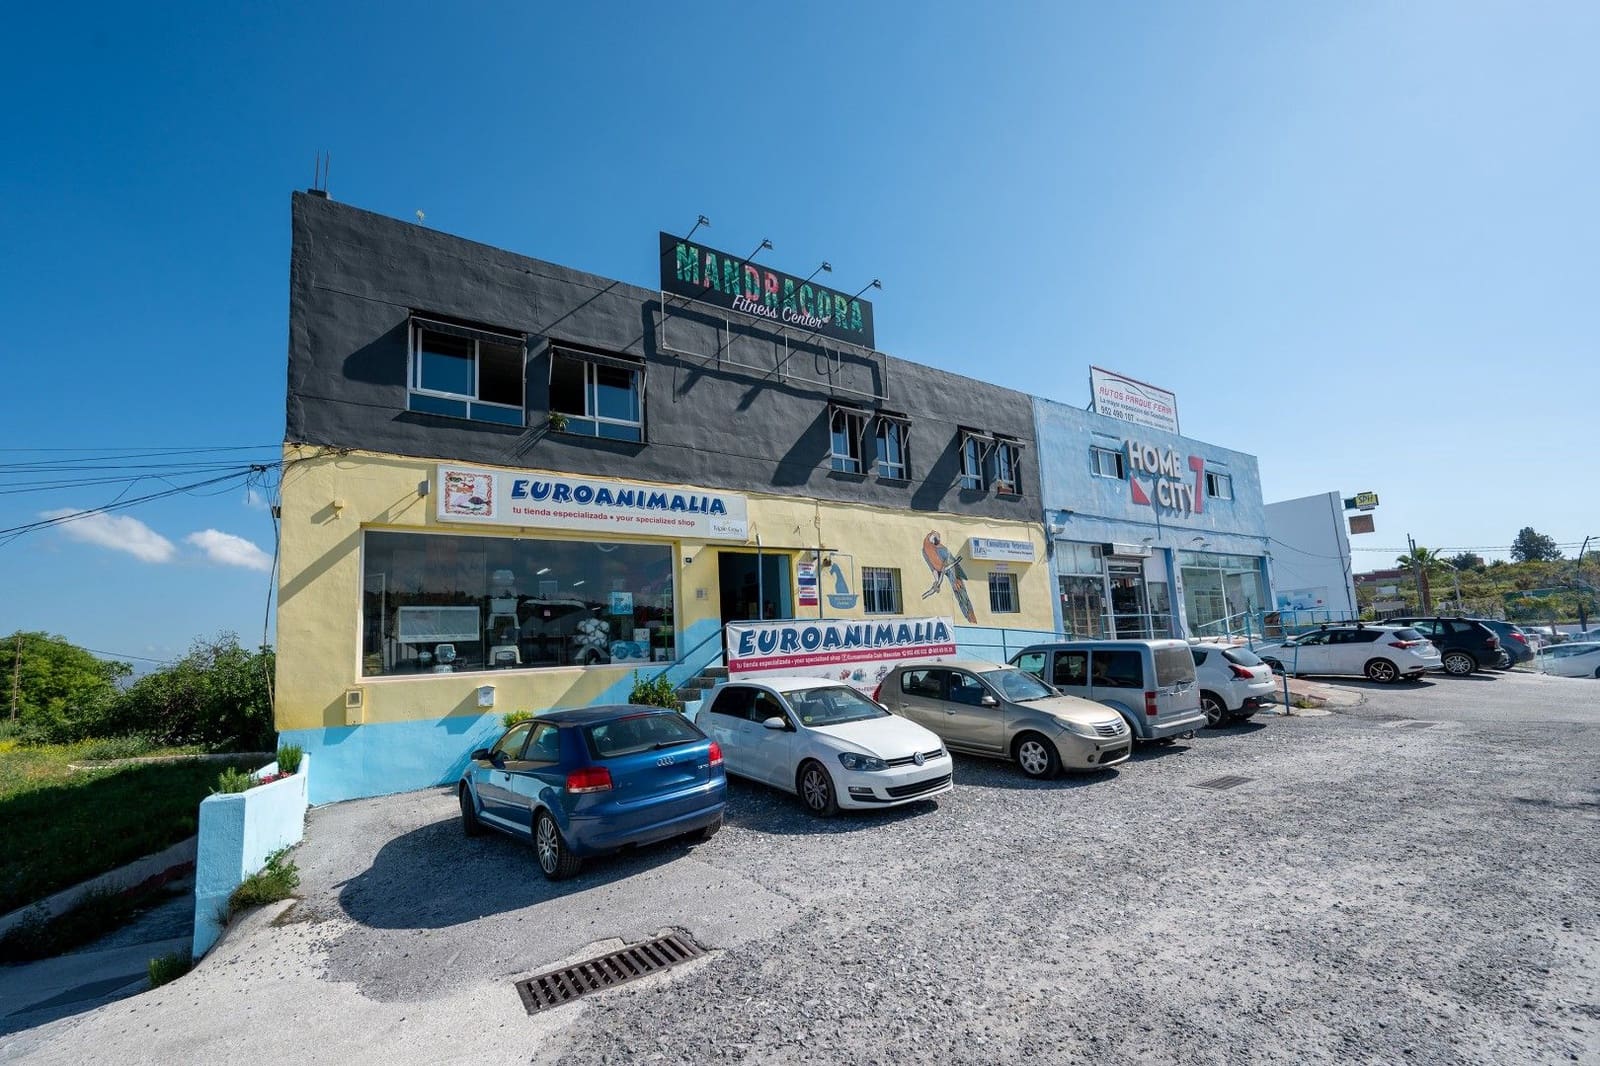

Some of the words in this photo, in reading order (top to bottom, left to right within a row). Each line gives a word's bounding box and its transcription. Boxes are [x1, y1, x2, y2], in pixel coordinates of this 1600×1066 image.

[676, 241, 864, 333] MANDRAGORA
[732, 295, 778, 319] Fitness
[781, 306, 824, 329] Center
[1099, 386, 1124, 401] AUTOS
[1125, 395, 1152, 409] PARQUE
[1128, 440, 1182, 478] HOME
[511, 479, 727, 515] EUROANIMALIA
[1157, 478, 1195, 512] CITY
[512, 506, 522, 514] tu
[524, 507, 551, 517] tienda
[553, 511, 608, 521] especializada
[615, 515, 634, 523] your
[635, 517, 676, 526] specialized
[738, 621, 951, 657] EUROANIMALIA
